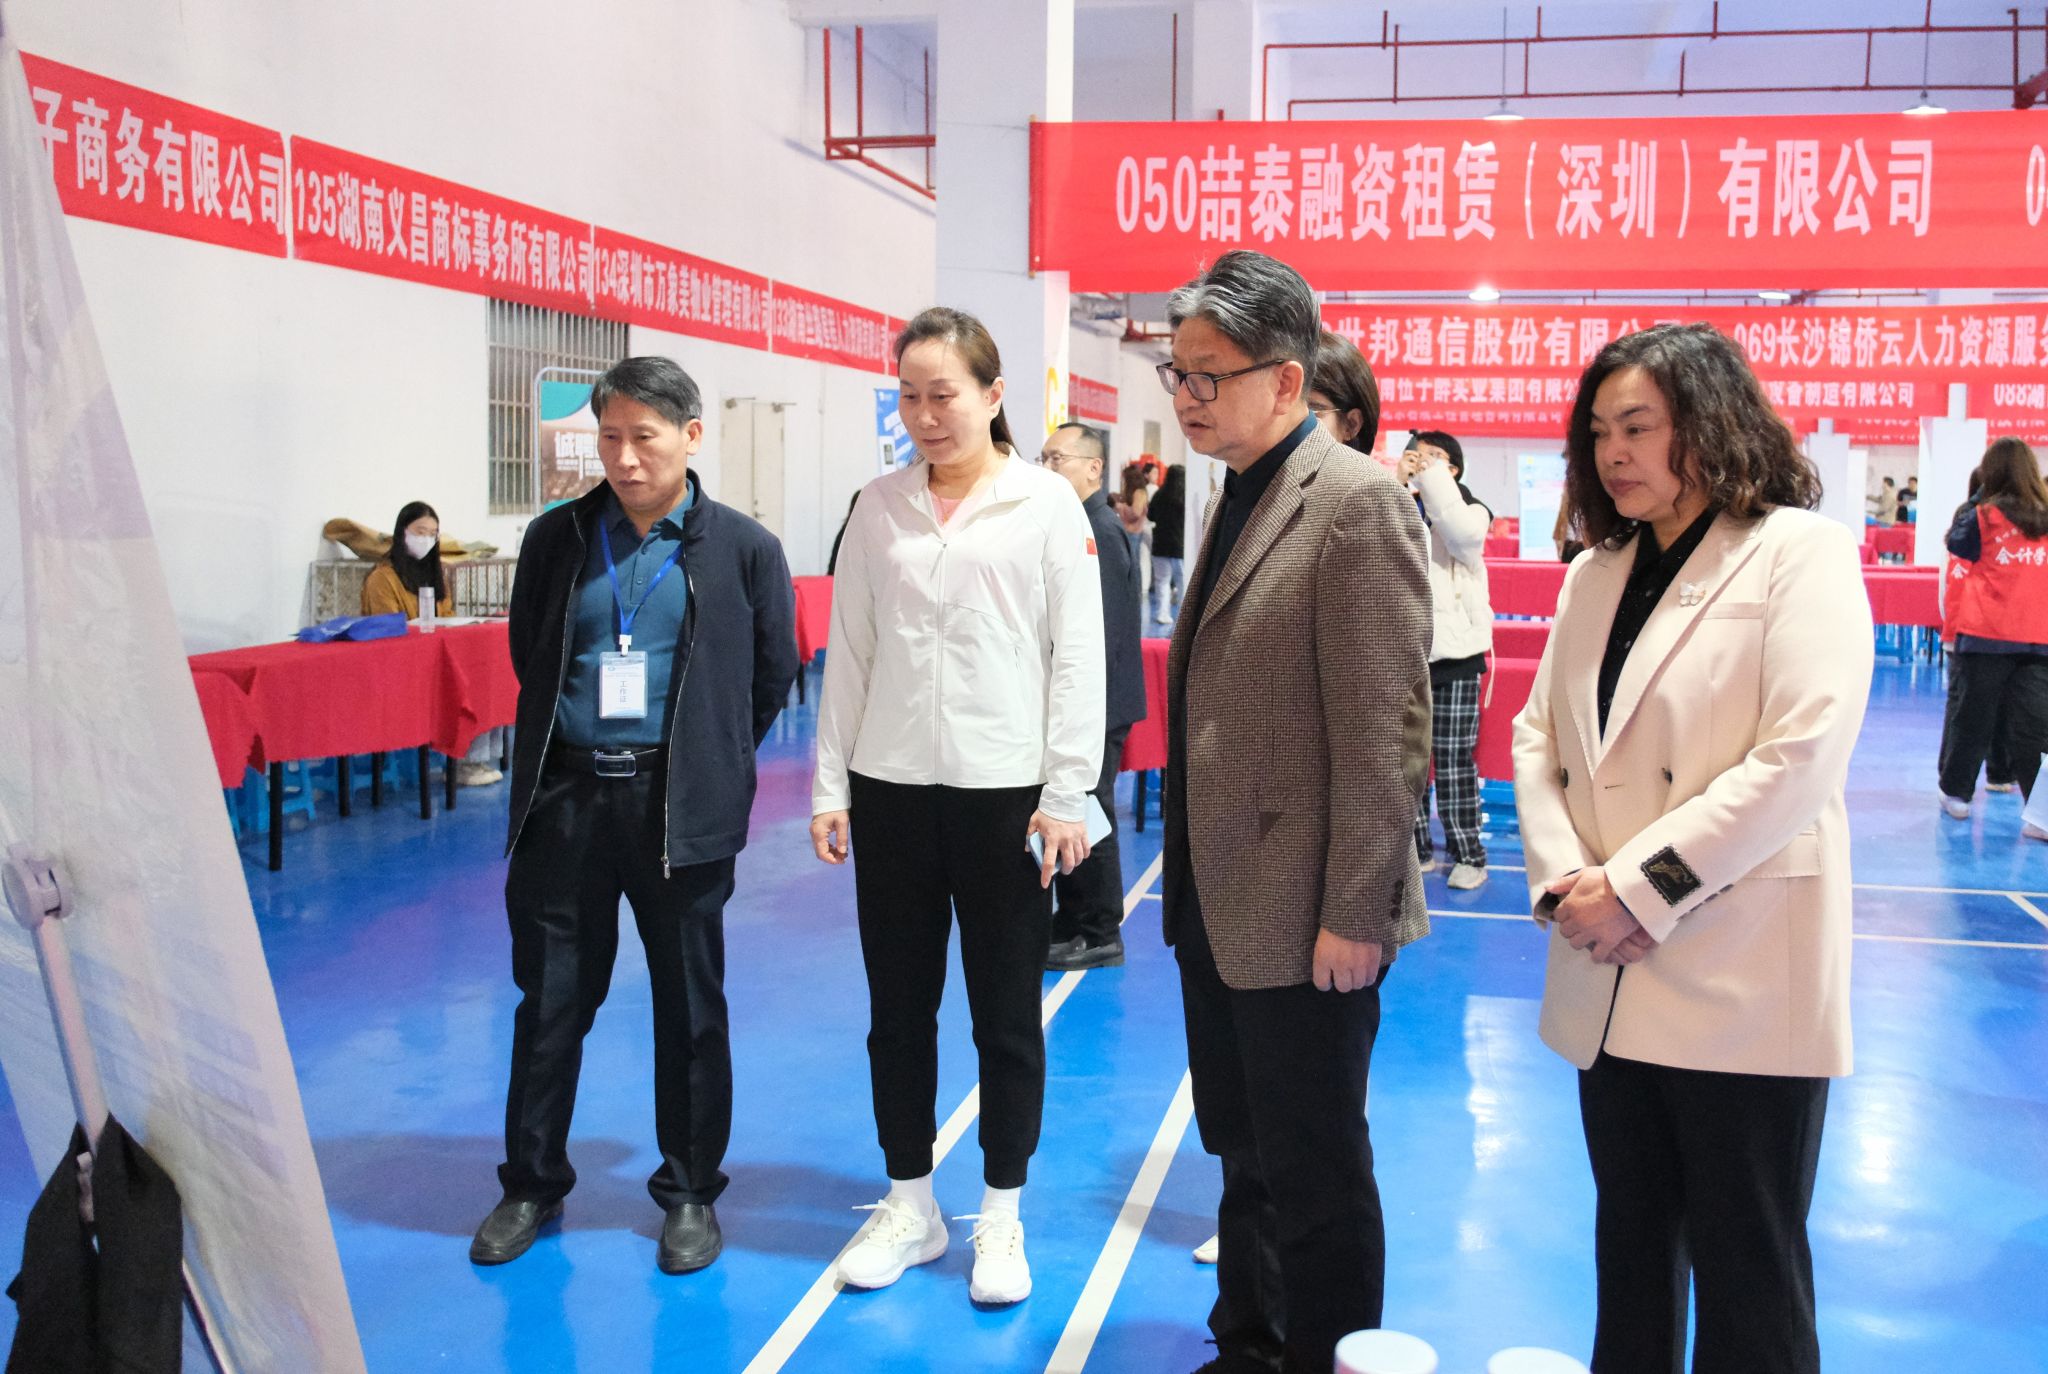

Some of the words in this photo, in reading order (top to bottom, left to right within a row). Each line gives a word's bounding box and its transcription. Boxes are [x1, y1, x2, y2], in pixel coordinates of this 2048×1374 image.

[32, 86, 285, 235] 子商务有限公司
[1116, 137, 1932, 243] 050喆泰融资租赁（深圳）有限公司
[2025, 144, 2048, 227] 0
[295, 168, 593, 301] 135湖南义昌商标事务所有限公司
[554, 432, 599, 480] 诚聘
